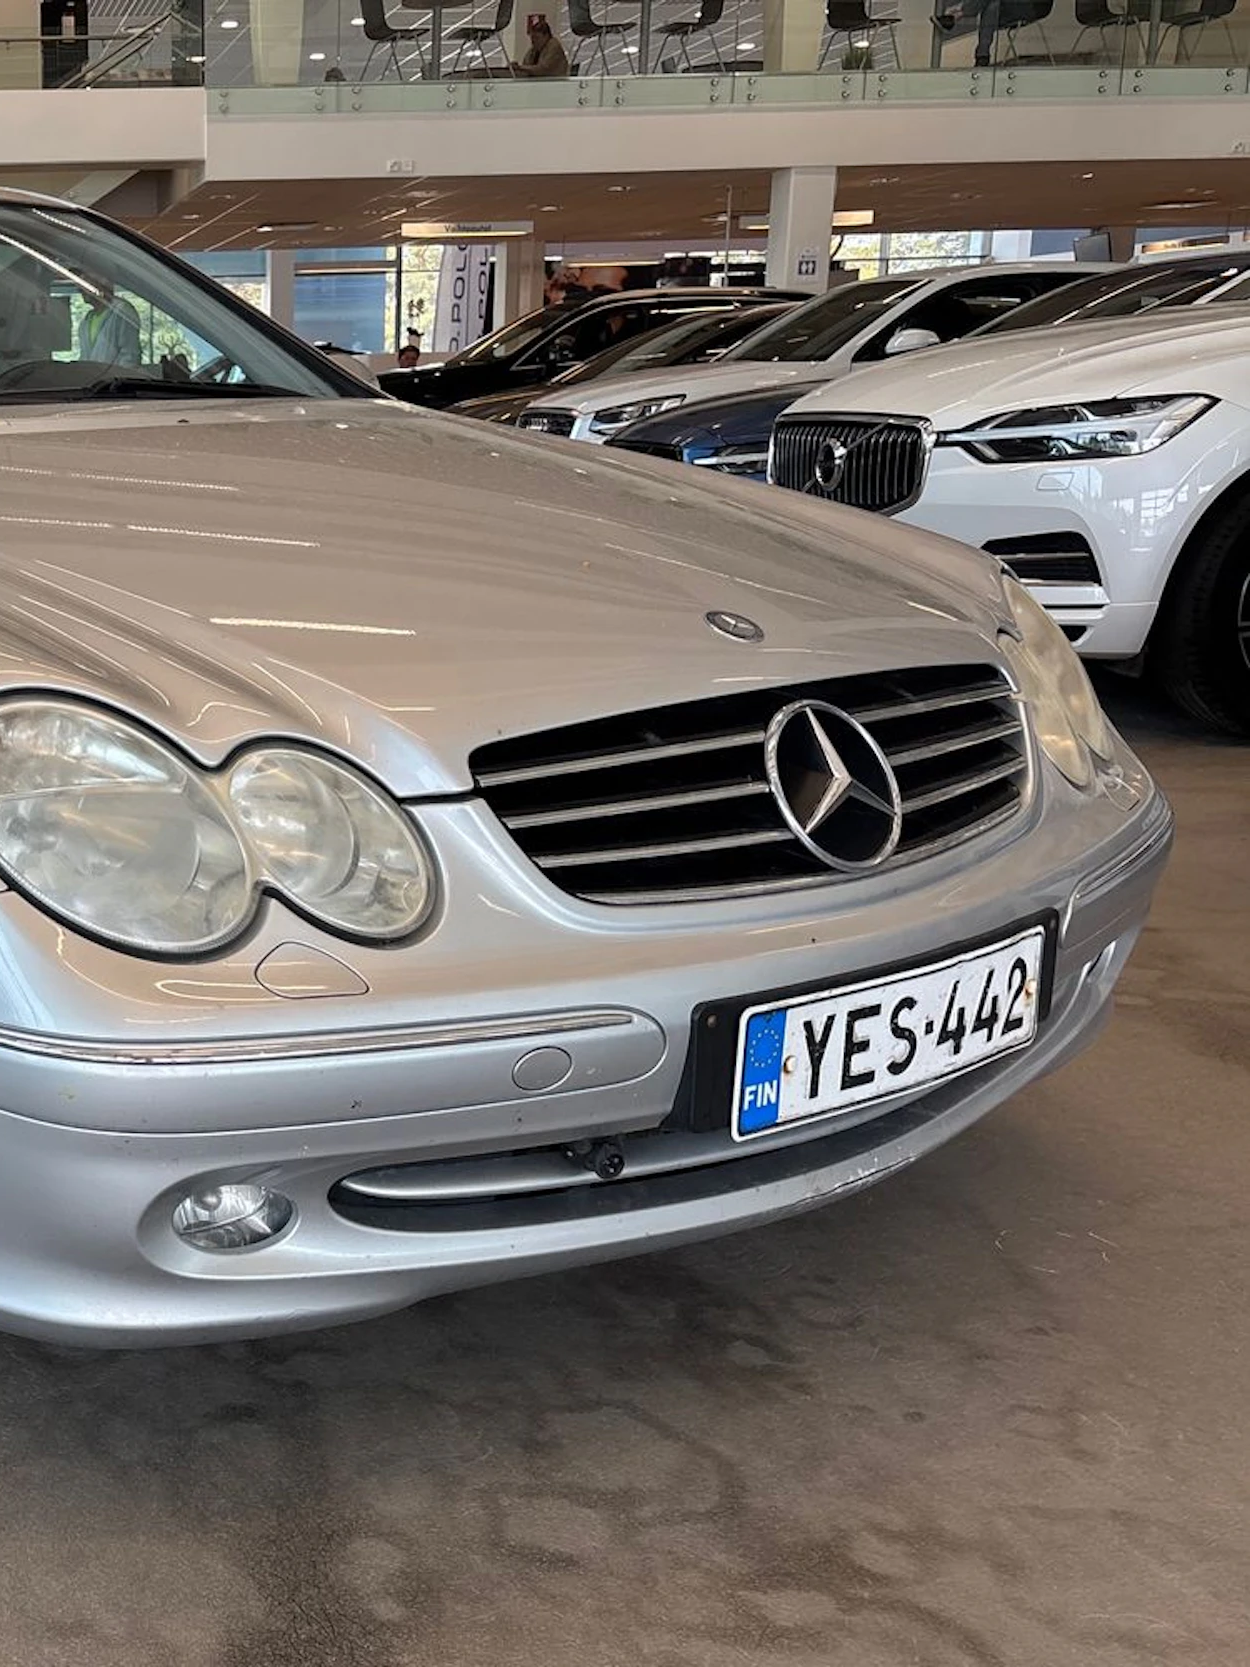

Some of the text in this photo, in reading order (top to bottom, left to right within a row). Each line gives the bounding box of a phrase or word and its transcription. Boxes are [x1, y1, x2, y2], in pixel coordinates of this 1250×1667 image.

[452, 245, 468, 322] POL
[803, 957, 1027, 1099] YES-442
[744, 1079, 778, 1111] FIN
